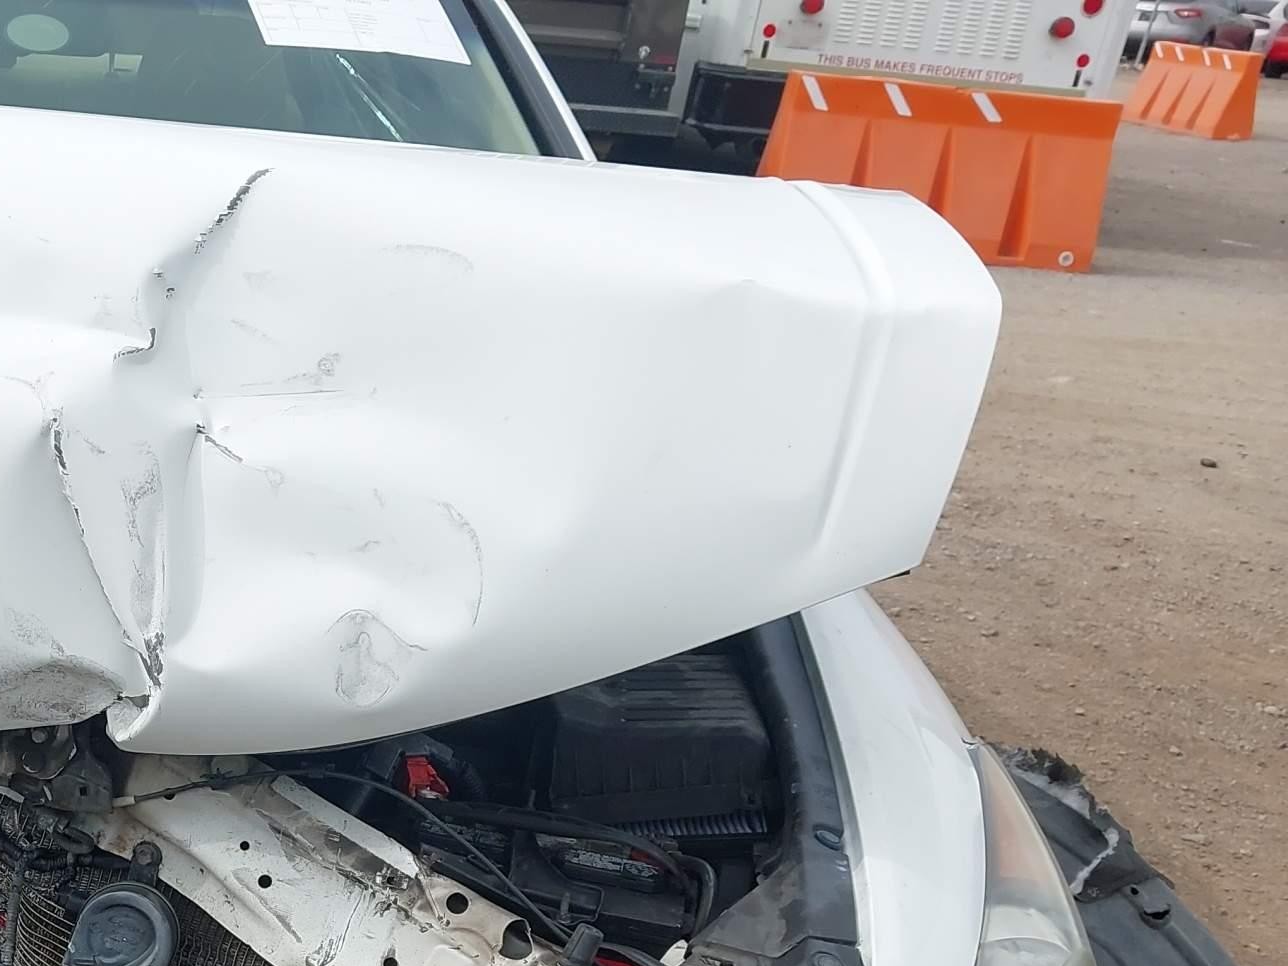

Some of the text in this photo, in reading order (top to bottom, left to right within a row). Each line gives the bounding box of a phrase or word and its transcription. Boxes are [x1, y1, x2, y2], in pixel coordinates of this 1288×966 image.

[817, 53, 1024, 83] THIS BUS MAKES FREQUENT STOPS
